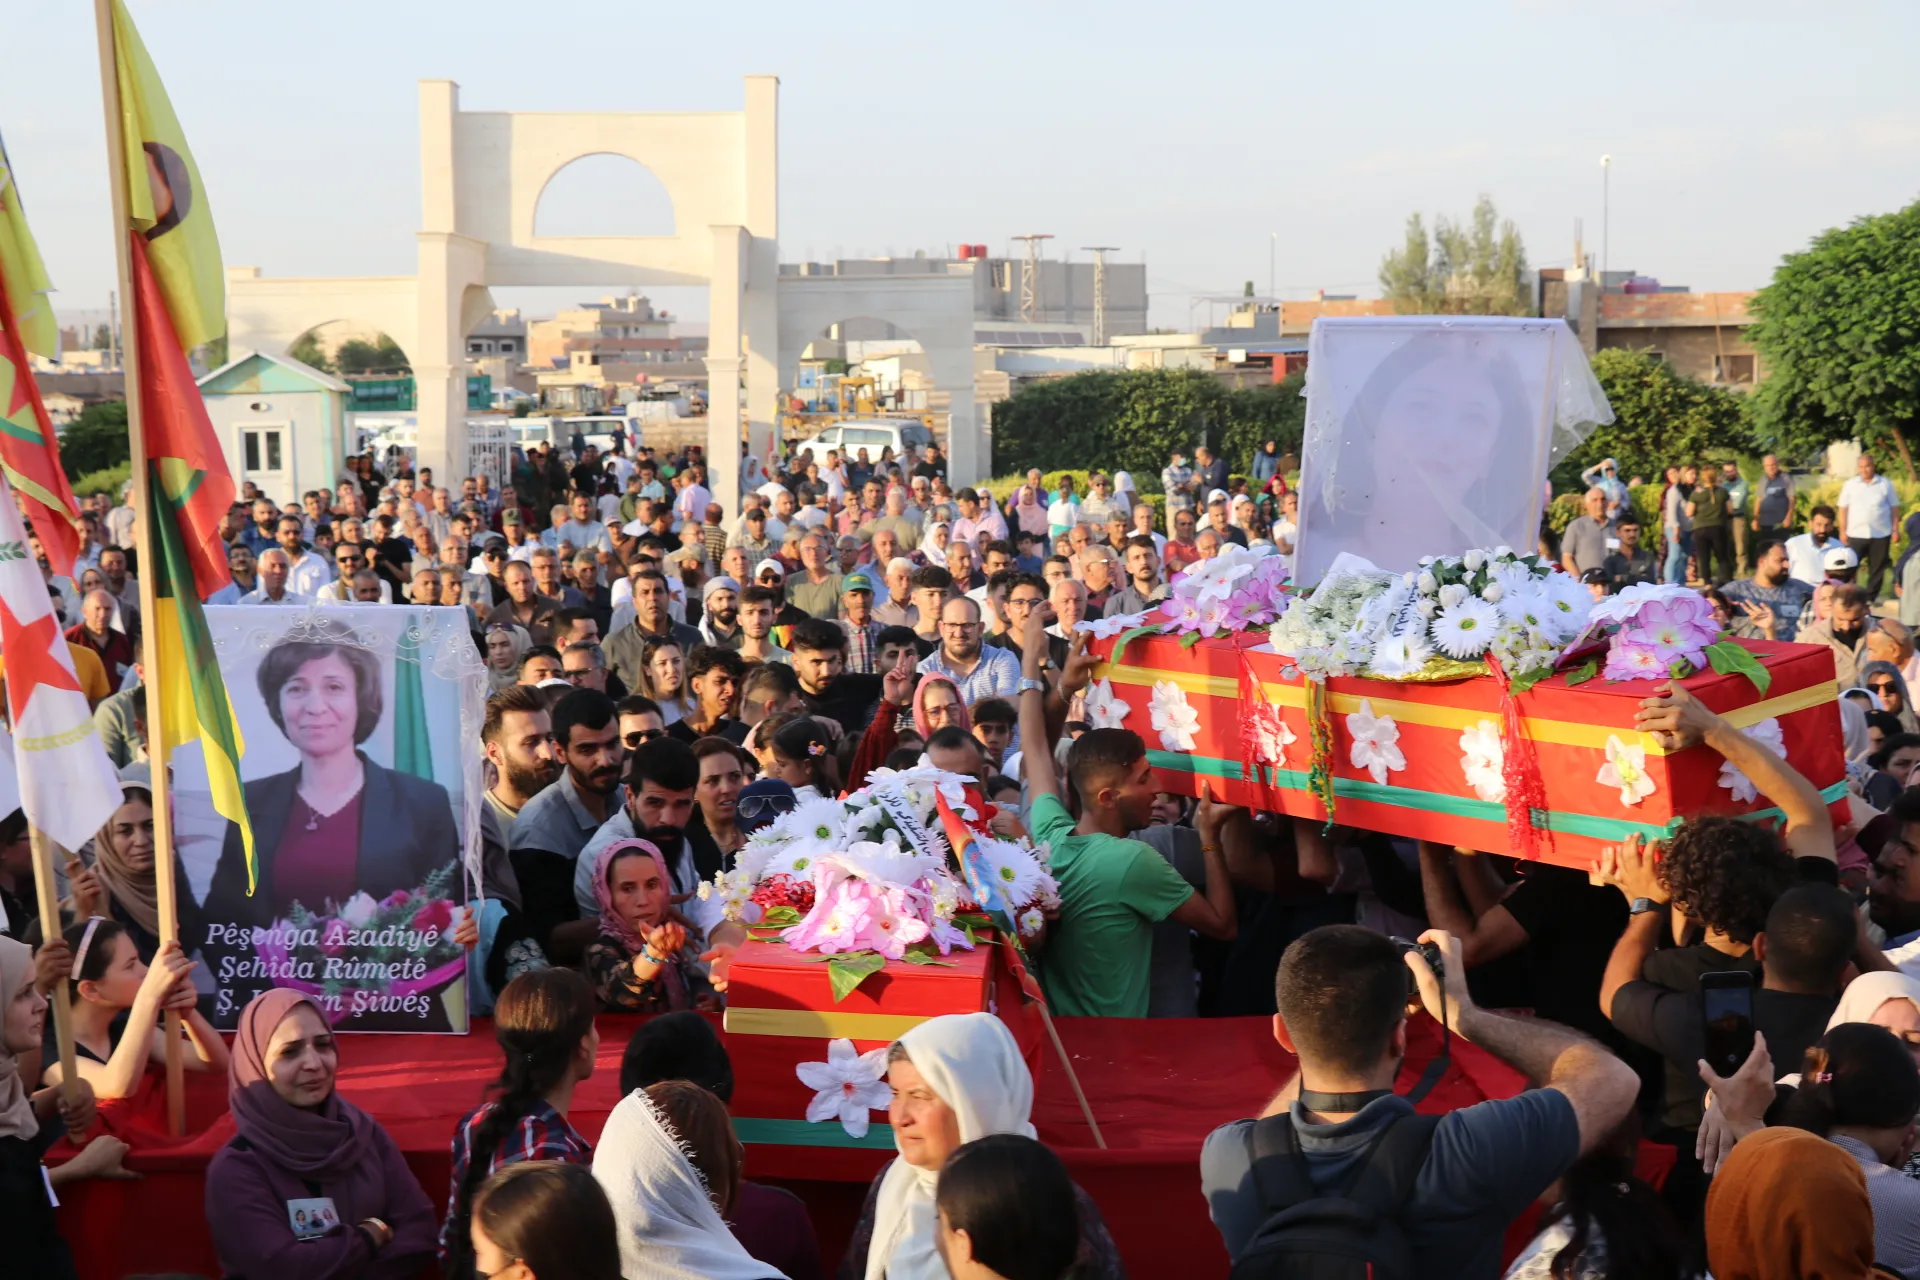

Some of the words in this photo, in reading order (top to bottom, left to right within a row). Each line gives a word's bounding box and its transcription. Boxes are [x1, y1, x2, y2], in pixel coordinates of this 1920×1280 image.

[205, 922, 319, 951] Pêşenga
[325, 924, 439, 952] Azadiyê
[219, 956, 316, 983] Şehîda
[322, 956, 427, 980] Rûmetê
[216, 988, 241, 1016] Ş.
[350, 989, 431, 1018] Şiwêş
